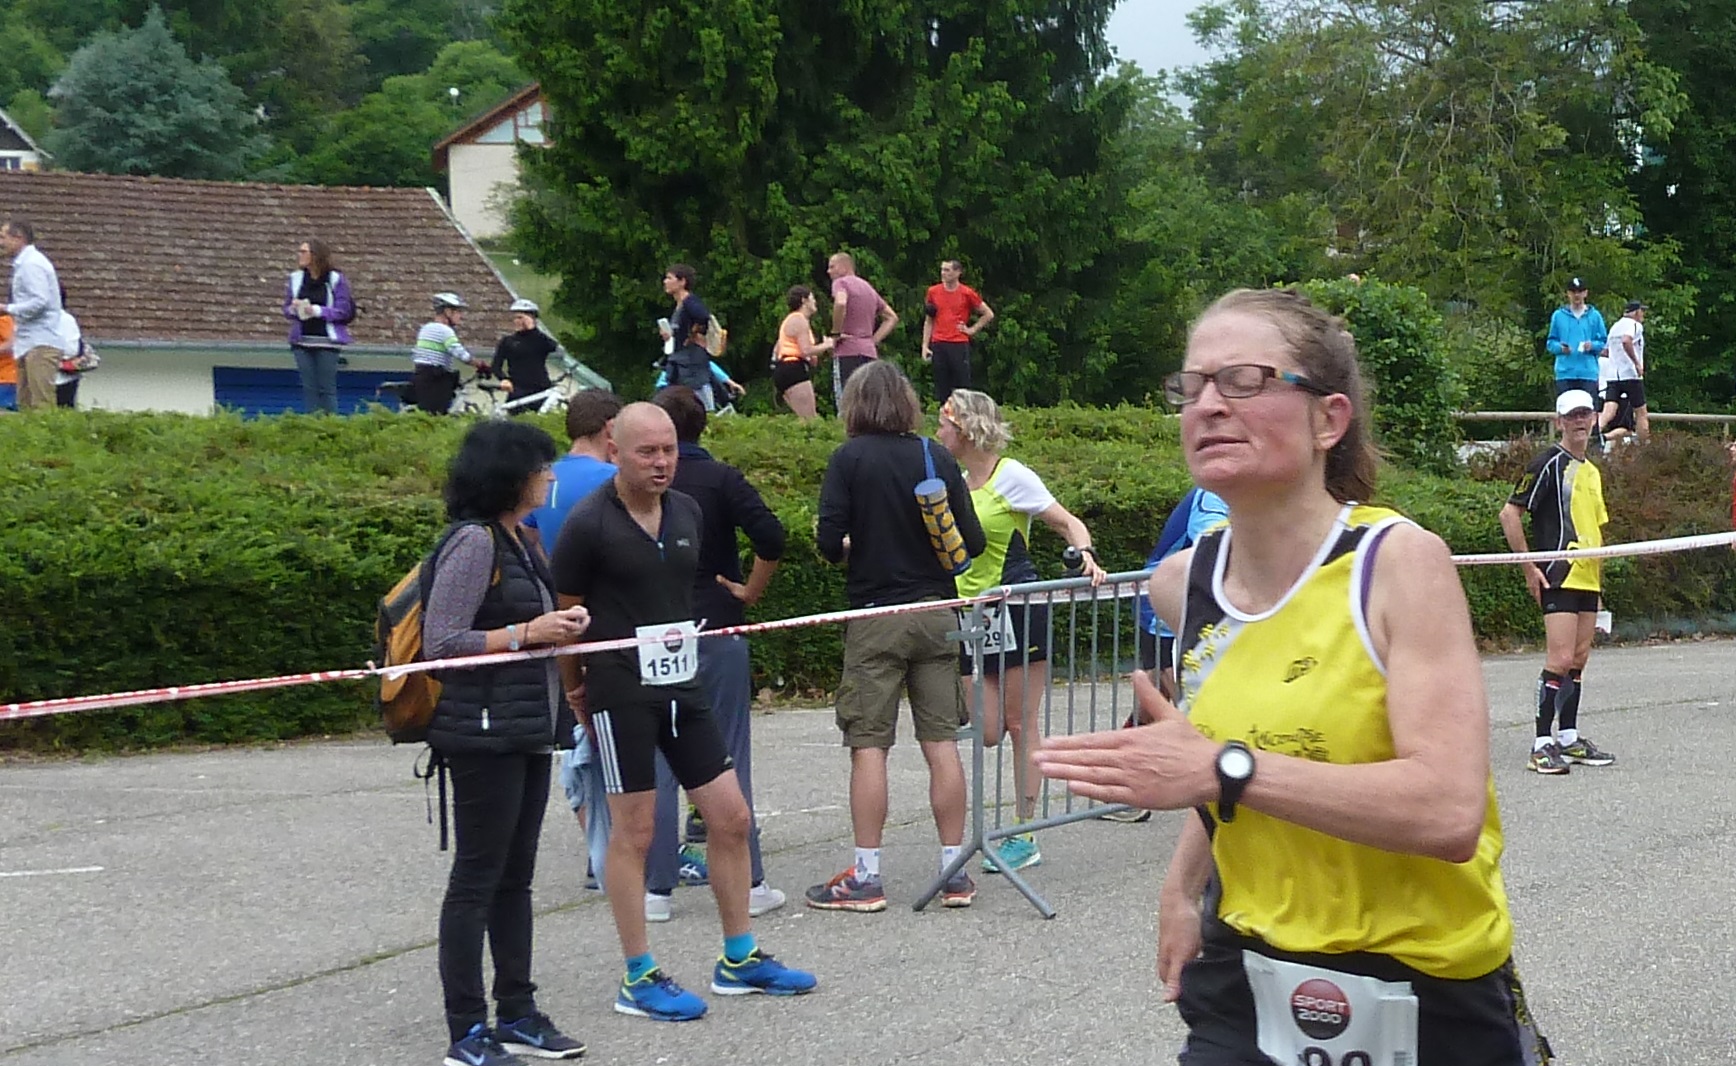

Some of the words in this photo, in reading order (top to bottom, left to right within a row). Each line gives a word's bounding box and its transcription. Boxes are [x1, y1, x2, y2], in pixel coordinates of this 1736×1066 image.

[647, 654, 687, 677] 1511
[1293, 994, 1347, 1014] SPORT
[1298, 1008, 1342, 1024] 2000
